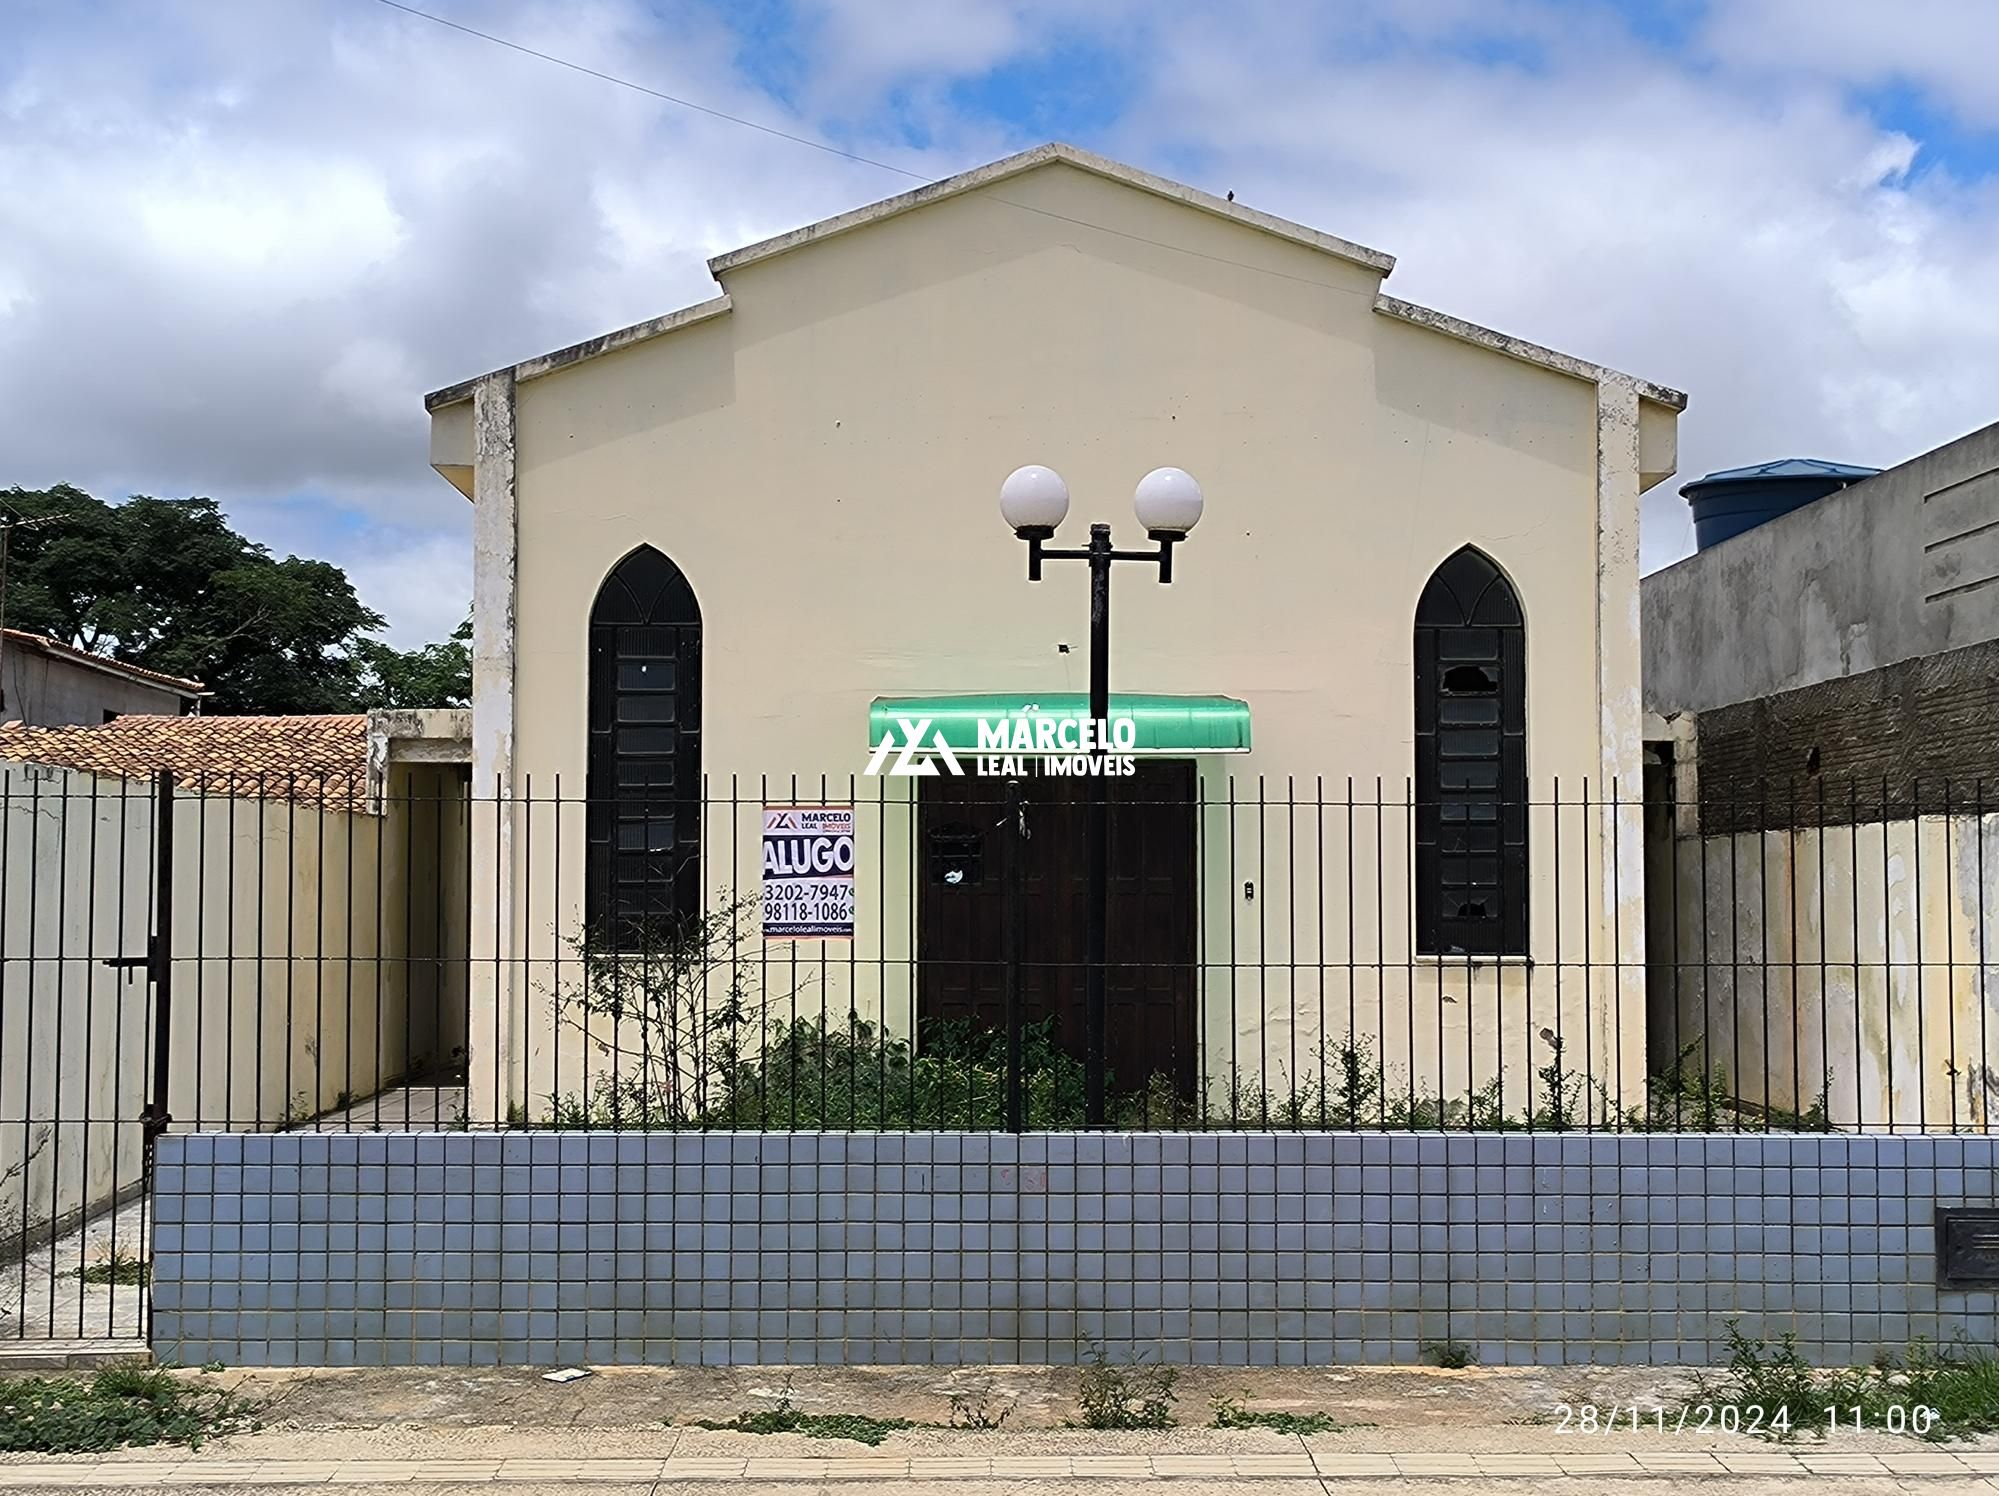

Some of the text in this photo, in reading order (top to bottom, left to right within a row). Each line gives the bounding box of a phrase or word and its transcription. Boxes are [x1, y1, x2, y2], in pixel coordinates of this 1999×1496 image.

[801, 812, 851, 822] MARCELO
[763, 836, 854, 875] ALUGO
[765, 884, 848, 900] 3202-7947
[765, 902, 848, 920] 98118-1086
